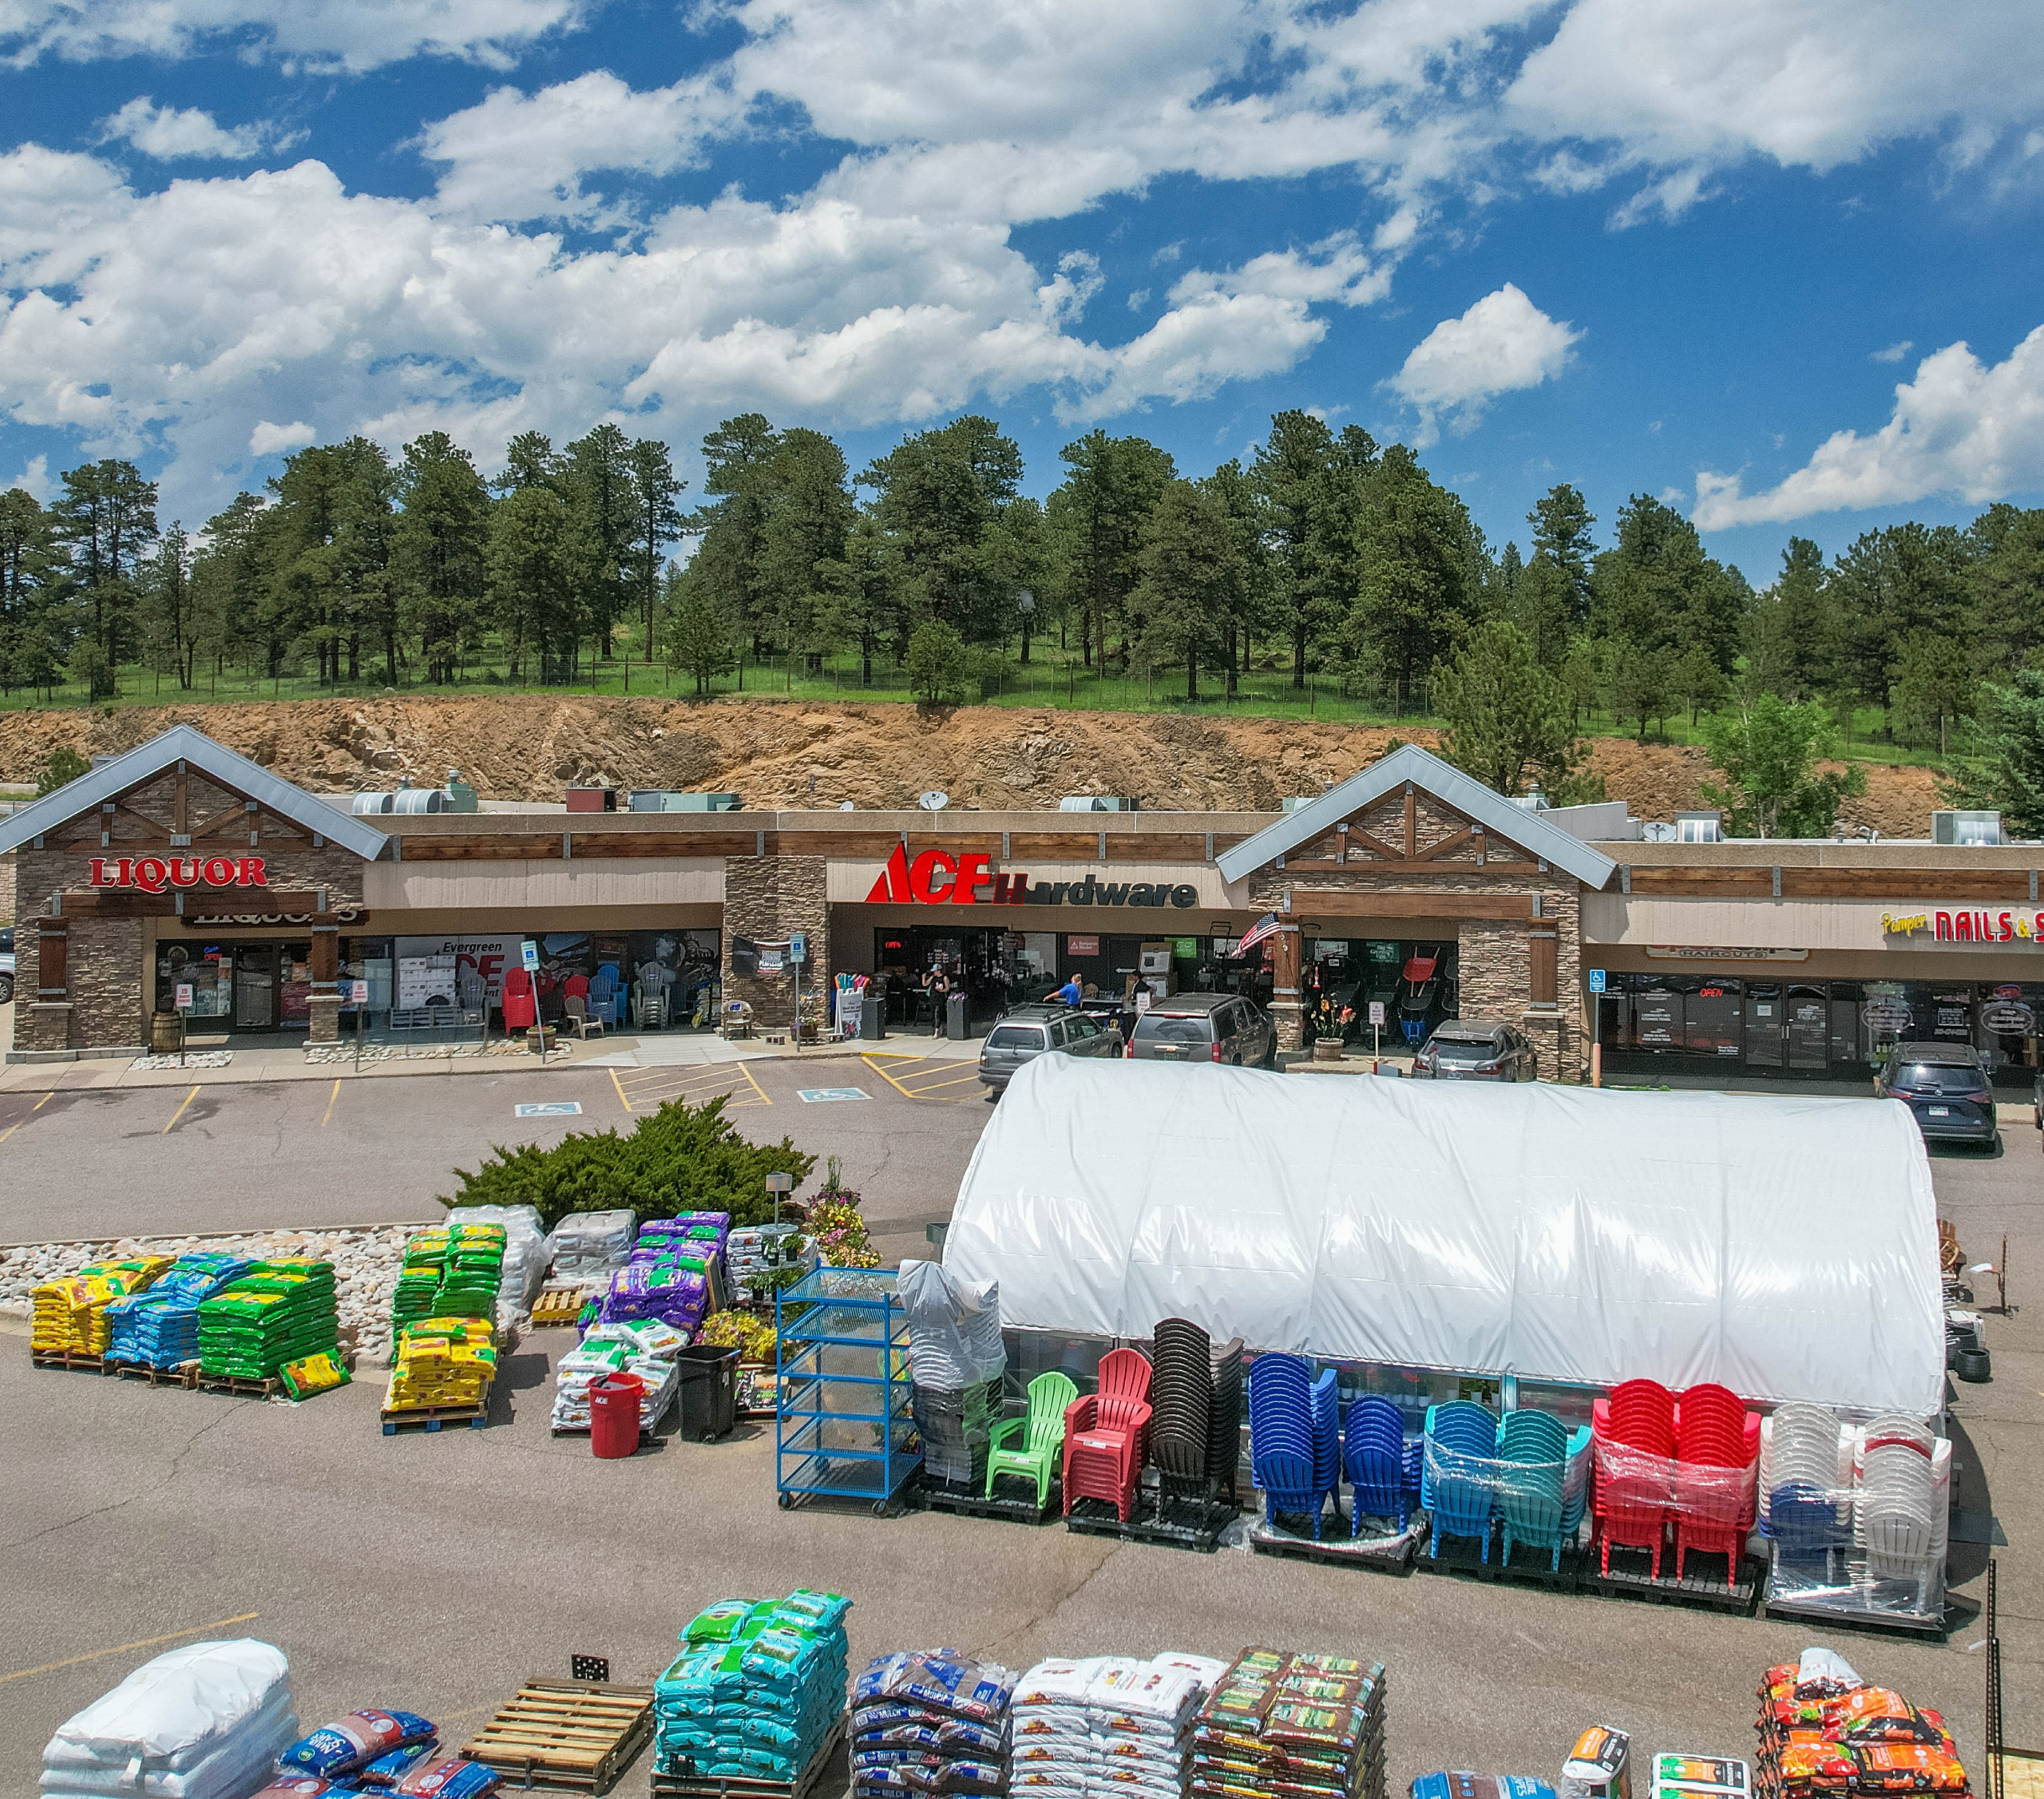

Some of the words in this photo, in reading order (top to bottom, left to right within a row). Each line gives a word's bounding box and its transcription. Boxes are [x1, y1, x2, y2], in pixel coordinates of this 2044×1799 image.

[88, 856, 269, 894] LIQUOR
[865, 841, 992, 905] ACE
[992, 874, 1199, 908] Hardware
[1881, 911, 1927, 937] Pamper
[1934, 909, 2014, 943] NAILS
[2017, 917, 2032, 938] &
[443, 942, 502, 954] Evergreen
[1682, 949, 1764, 958] HAIRCUTS
[1700, 988, 1724, 997] OPEN
[877, 1752, 900, 1761] MULCH
[882, 1789, 904, 1798] MULCH
